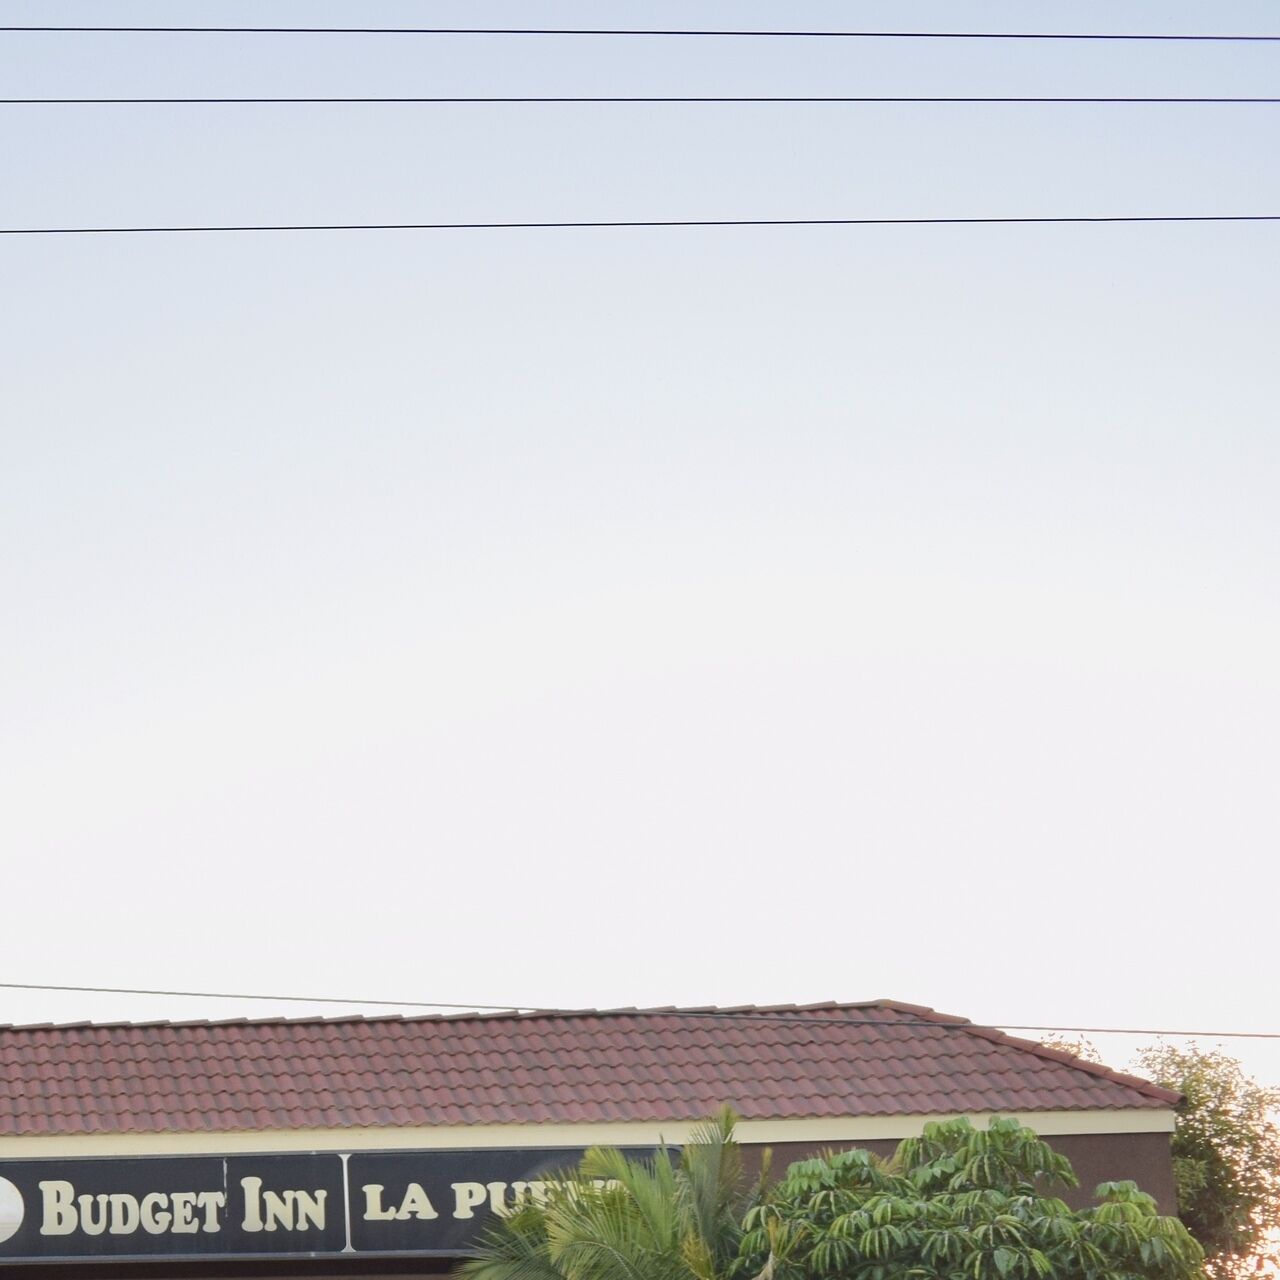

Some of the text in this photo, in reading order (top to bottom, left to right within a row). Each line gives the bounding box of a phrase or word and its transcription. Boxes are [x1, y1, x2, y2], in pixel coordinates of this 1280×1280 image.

[39, 1176, 328, 1236] BUDGET INN
[362, 1183, 439, 1221] LA
